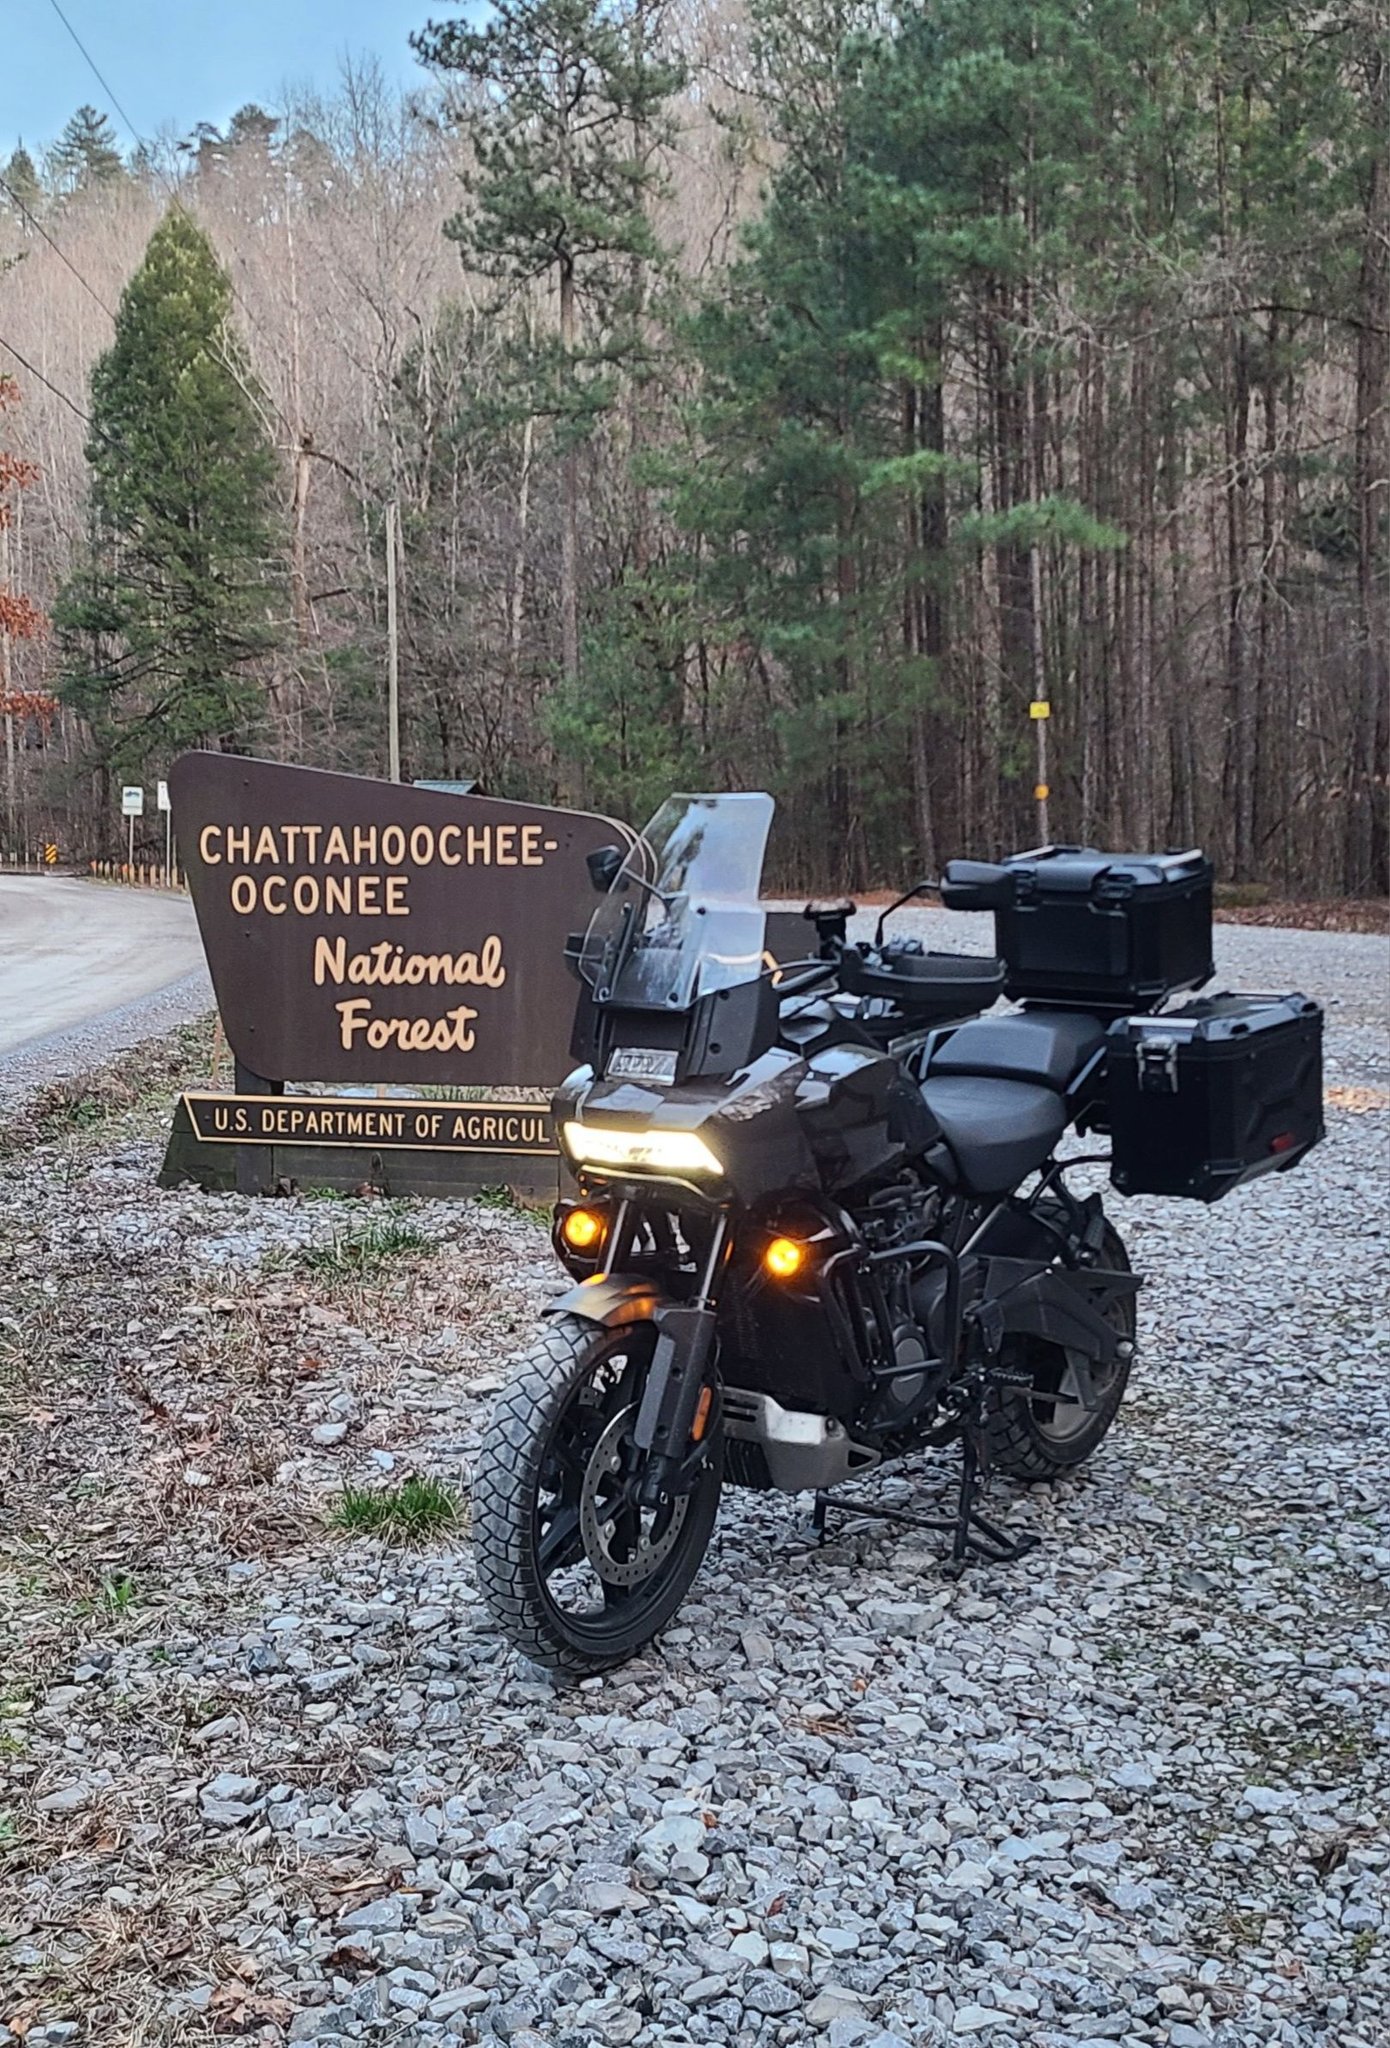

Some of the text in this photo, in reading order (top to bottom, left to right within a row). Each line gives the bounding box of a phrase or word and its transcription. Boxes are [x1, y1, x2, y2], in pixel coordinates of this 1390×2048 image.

[200, 825, 558, 866] CHATTAHOOCHEE-
[231, 875, 410, 915] OCONEE
[314, 935, 506, 988] National
[335, 998, 478, 1052] Forest
[215, 1107, 551, 1143] U.S. DEPARTMENT OF AGRICUL
